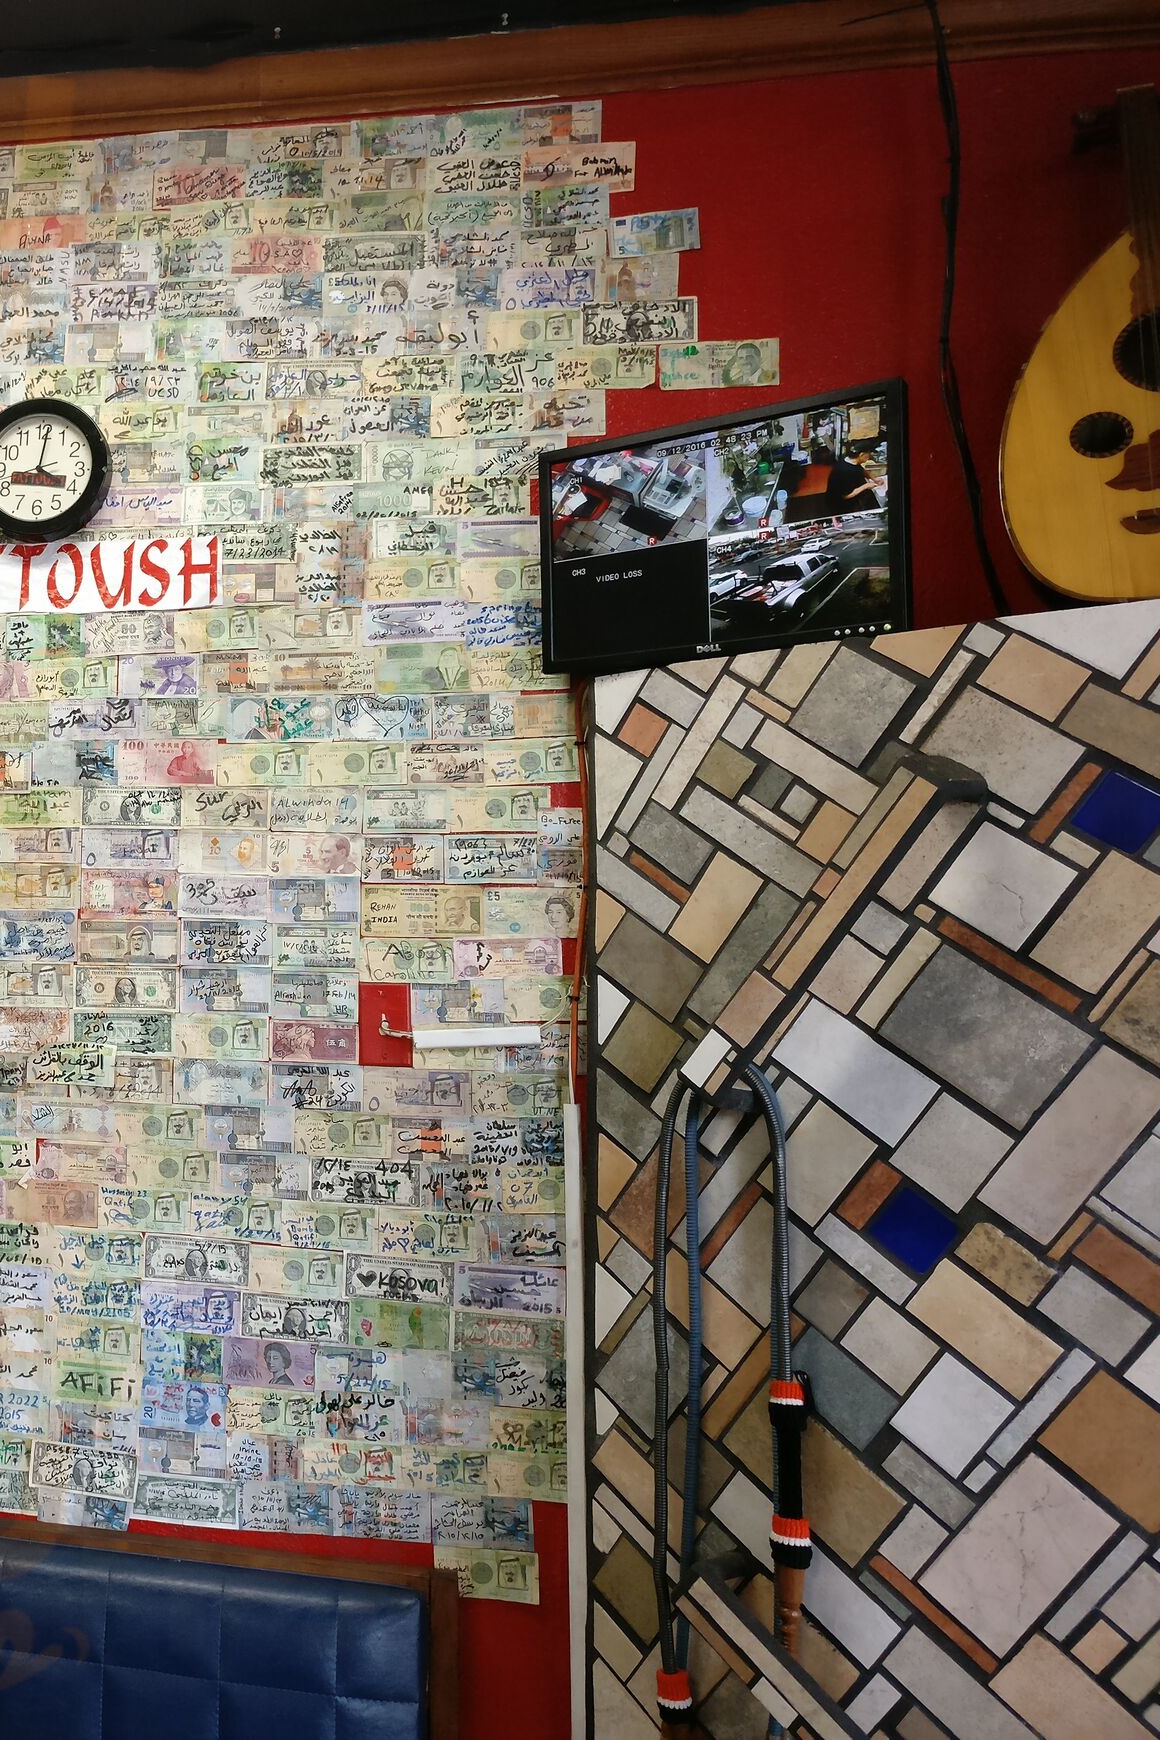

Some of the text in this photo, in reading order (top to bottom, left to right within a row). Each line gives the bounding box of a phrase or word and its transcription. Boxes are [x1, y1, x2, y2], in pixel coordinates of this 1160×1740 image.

[17, 430, 29, 446] 11
[35, 424, 52, 440] 12
[59, 430, 65, 446] 1
[756, 429, 768, 437] PM
[2, 445, 19, 460] 10
[69, 442, 80, 457] 2
[714, 448, 729, 456] CH2
[74, 461, 85, 477] 3
[0, 481, 10, 497] 8
[66, 479, 77, 494] 4
[15, 495, 25, 510] 7
[32, 500, 42, 515] 6
[51, 494, 62, 510] 5
[716, 544, 733, 556] CH4
[596, 570, 642, 582] VIDEO LOSS
[696, 644, 721, 653] DELL
[183, 686, 197, 695] 20
[123, 741, 144, 750] 100
[371, 902, 396, 911] REHAN
[371, 916, 397, 924] INDIA
[84, 1022, 114, 1035] 2016
[375, 1159, 414, 1179] 404
[10, 1393, 38, 1406] 2022
